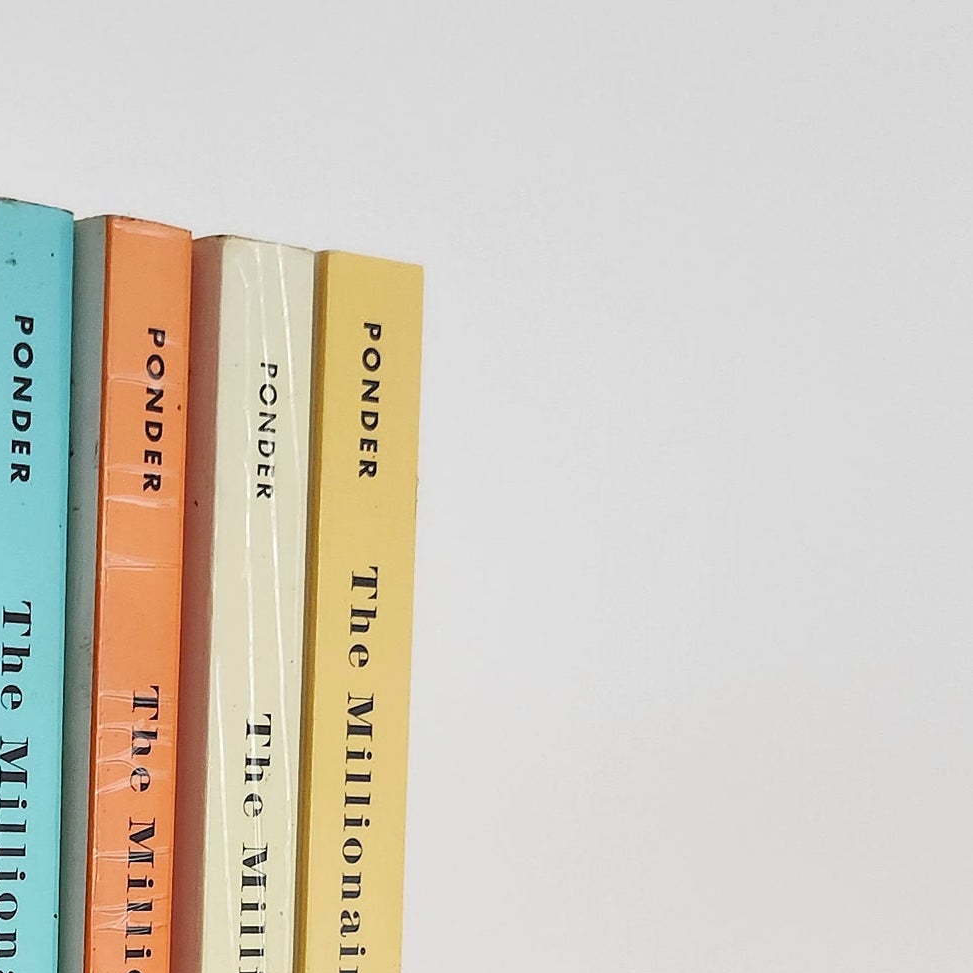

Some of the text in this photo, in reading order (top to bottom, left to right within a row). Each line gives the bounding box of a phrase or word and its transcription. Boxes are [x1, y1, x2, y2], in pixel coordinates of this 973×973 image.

[10, 314, 34, 483] PONDER
[142, 328, 166, 492] PONDER
[256, 362, 277, 499] PONDER
[359, 322, 381, 479] PONDER
[0, 600, 32, 711] The
[348, 566, 379, 668] The
[129, 685, 160, 793] The
[242, 713, 272, 818] The
